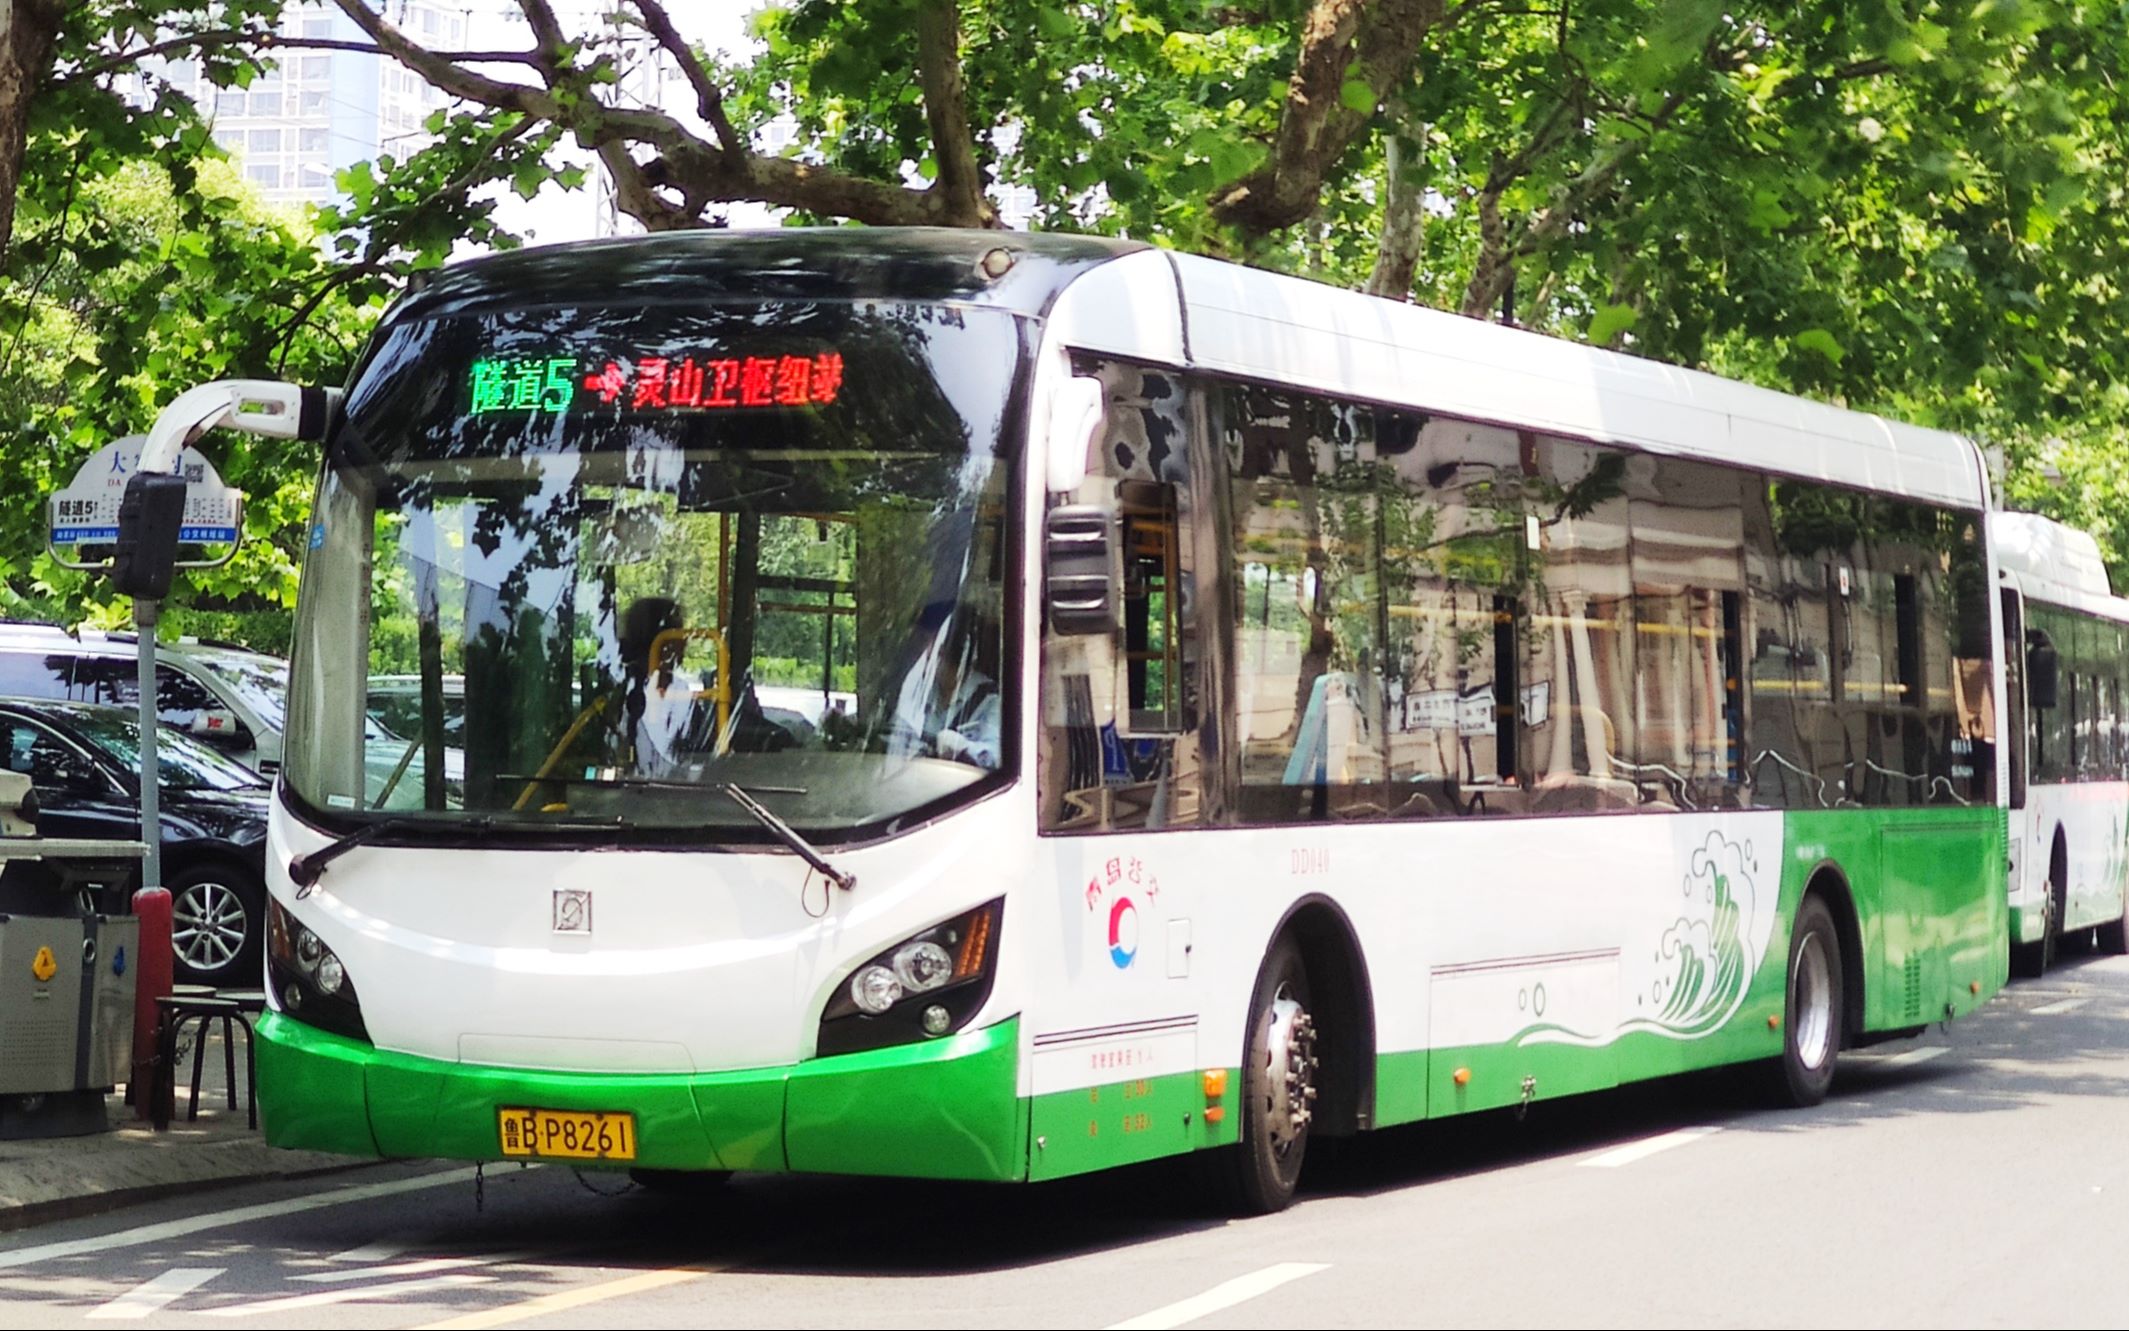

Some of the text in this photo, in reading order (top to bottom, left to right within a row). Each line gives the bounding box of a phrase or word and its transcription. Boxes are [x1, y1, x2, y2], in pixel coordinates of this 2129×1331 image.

[471, 352, 844, 413] 隧道5 灵山卫枢纽站
[58, 499, 93, 516] 隧道5
